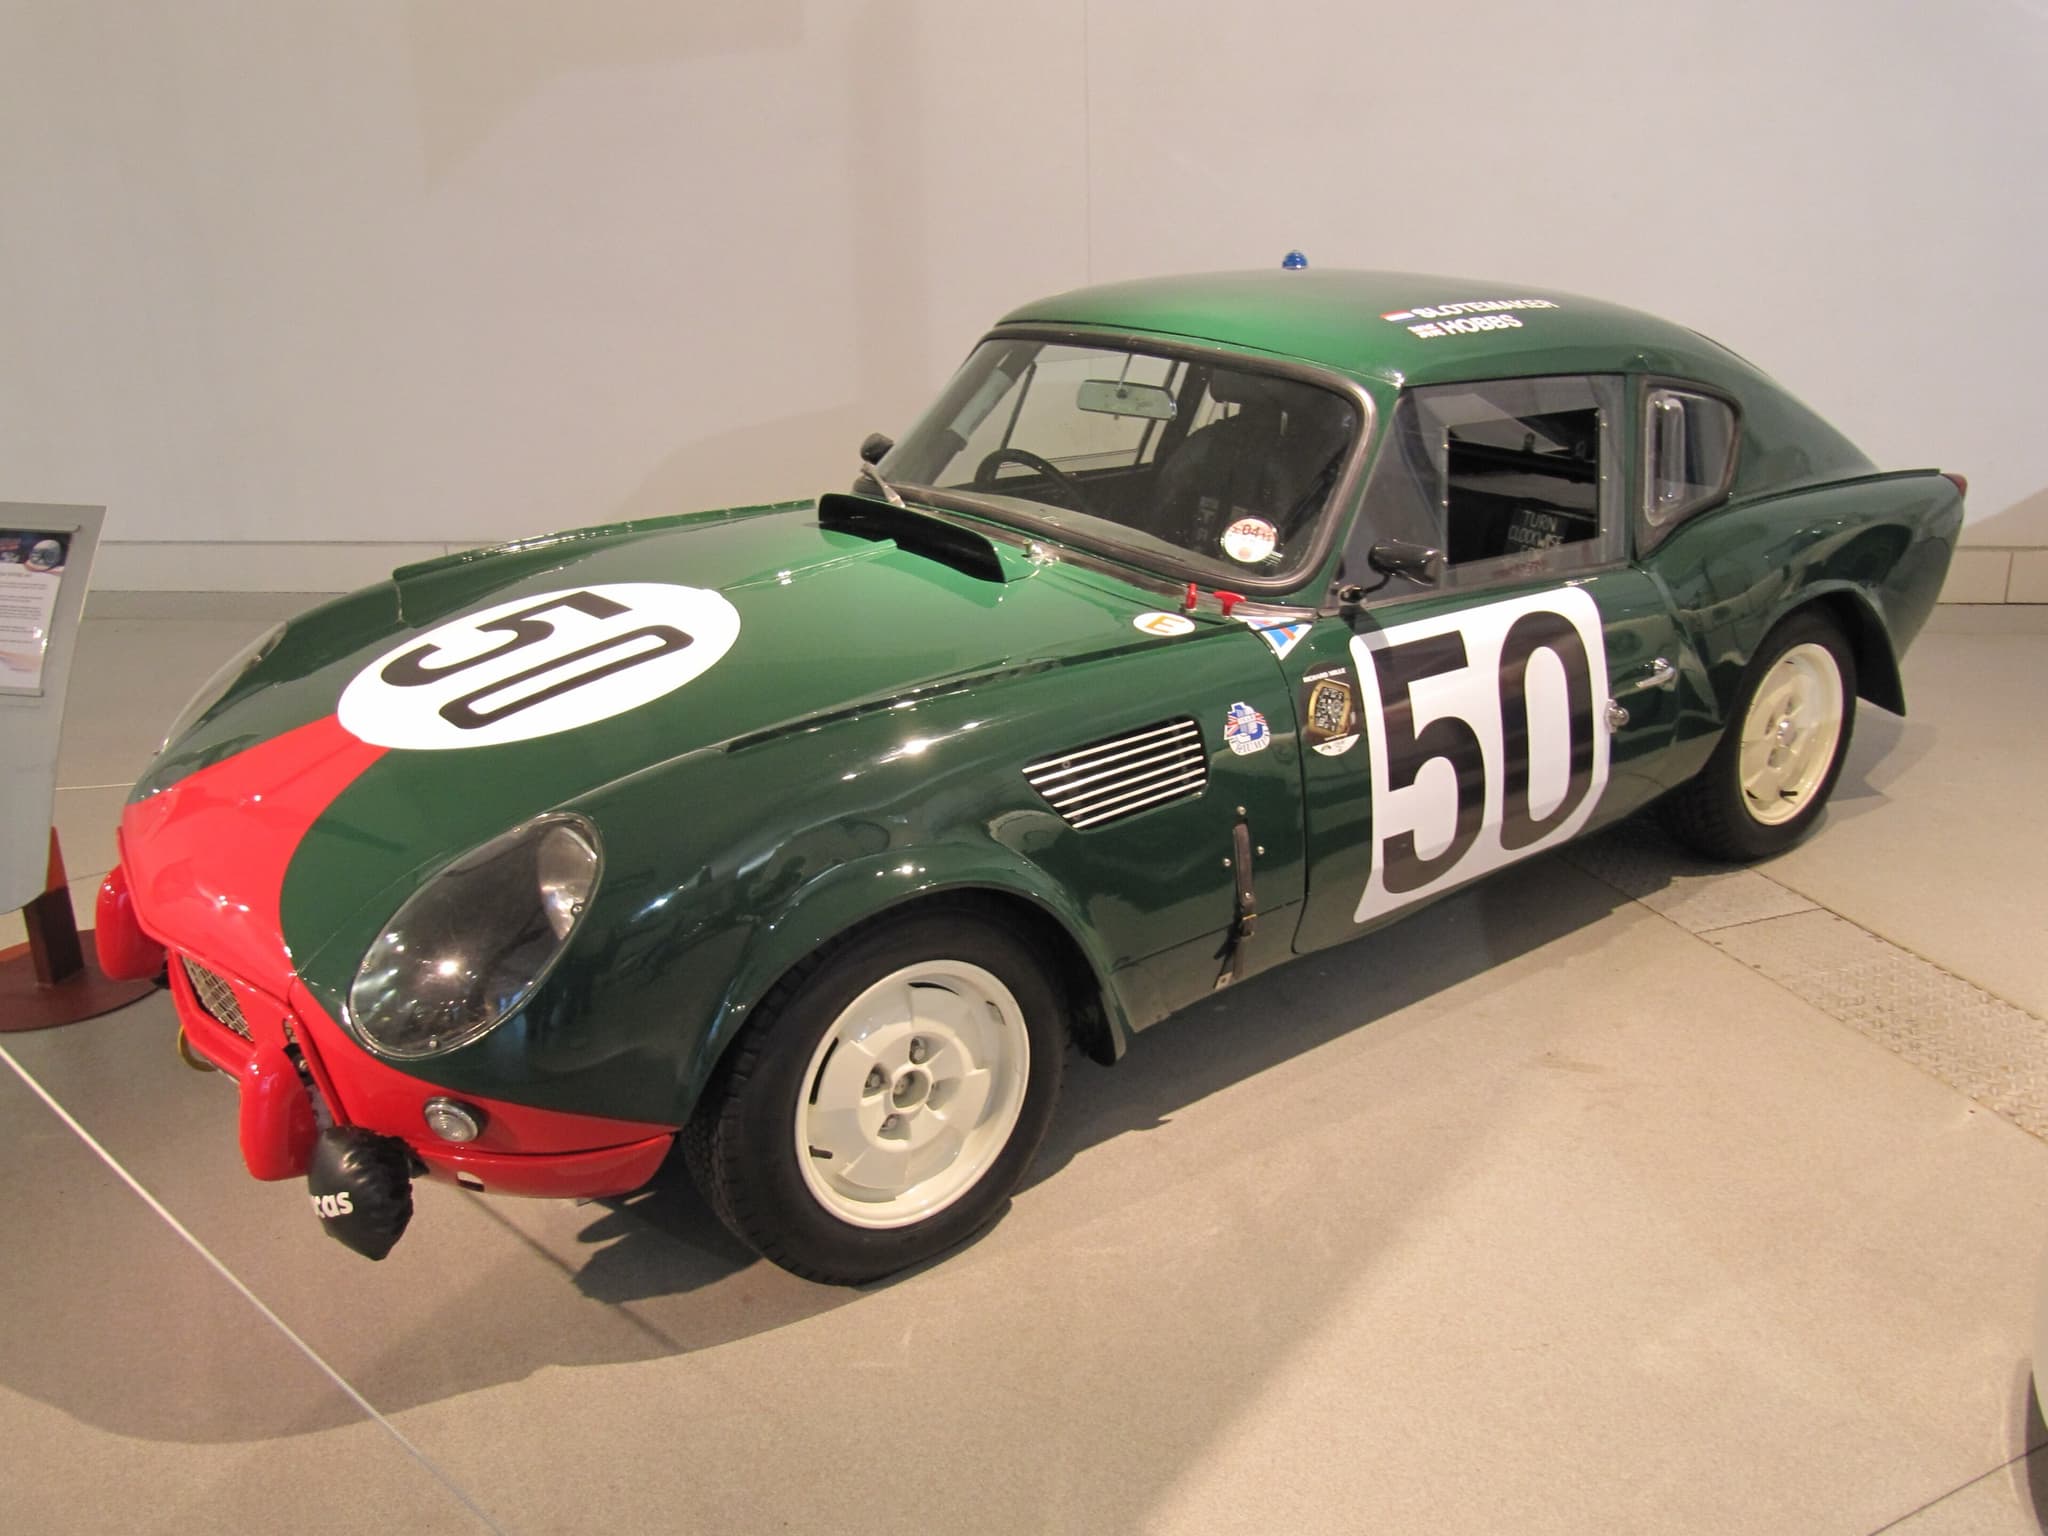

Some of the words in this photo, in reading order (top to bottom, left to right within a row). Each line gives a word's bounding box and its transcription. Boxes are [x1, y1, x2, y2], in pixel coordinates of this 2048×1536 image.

[1437, 314, 1523, 335] HOBBS
[1521, 509, 1558, 533] TURN
[1146, 615, 1186, 633] E
[381, 591, 694, 730] 50
[1371, 611, 1594, 894] 50
